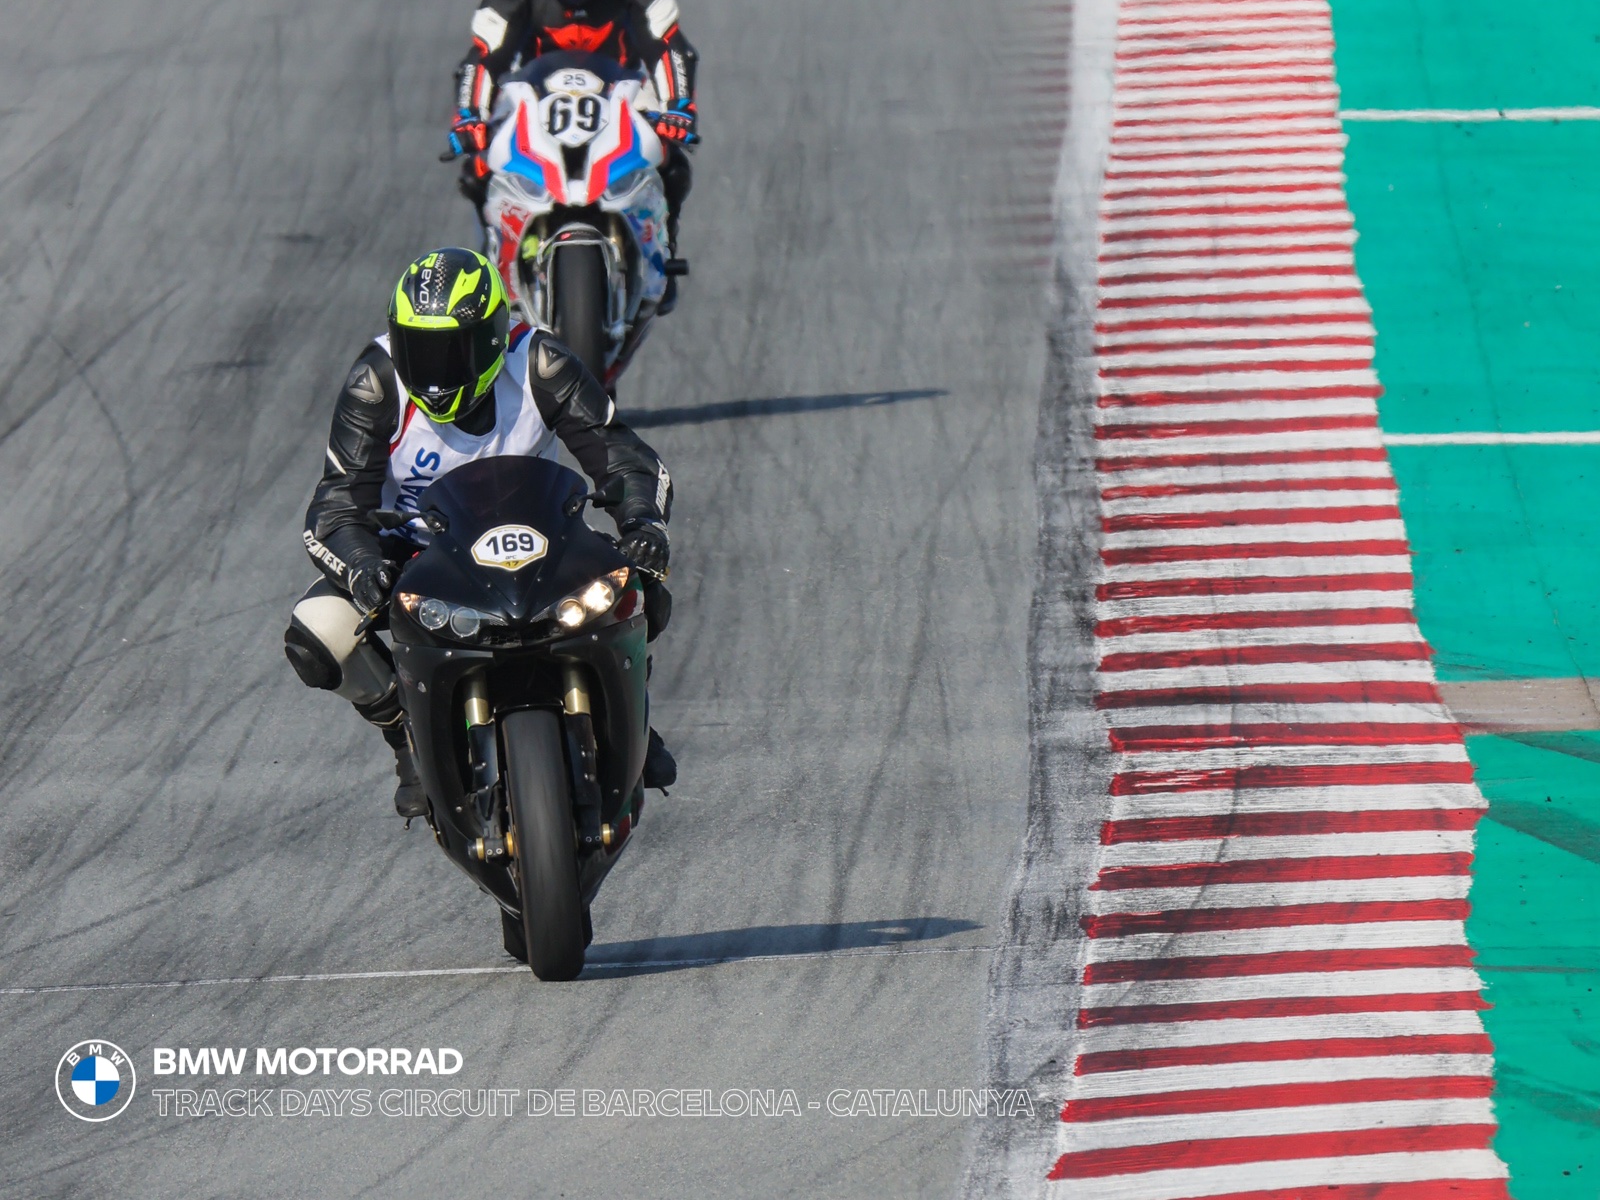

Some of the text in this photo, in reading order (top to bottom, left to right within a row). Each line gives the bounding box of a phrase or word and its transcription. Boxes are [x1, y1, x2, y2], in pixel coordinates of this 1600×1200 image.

[563, 74, 586, 86] 25
[548, 96, 602, 136] 69
[486, 533, 534, 555] 169
